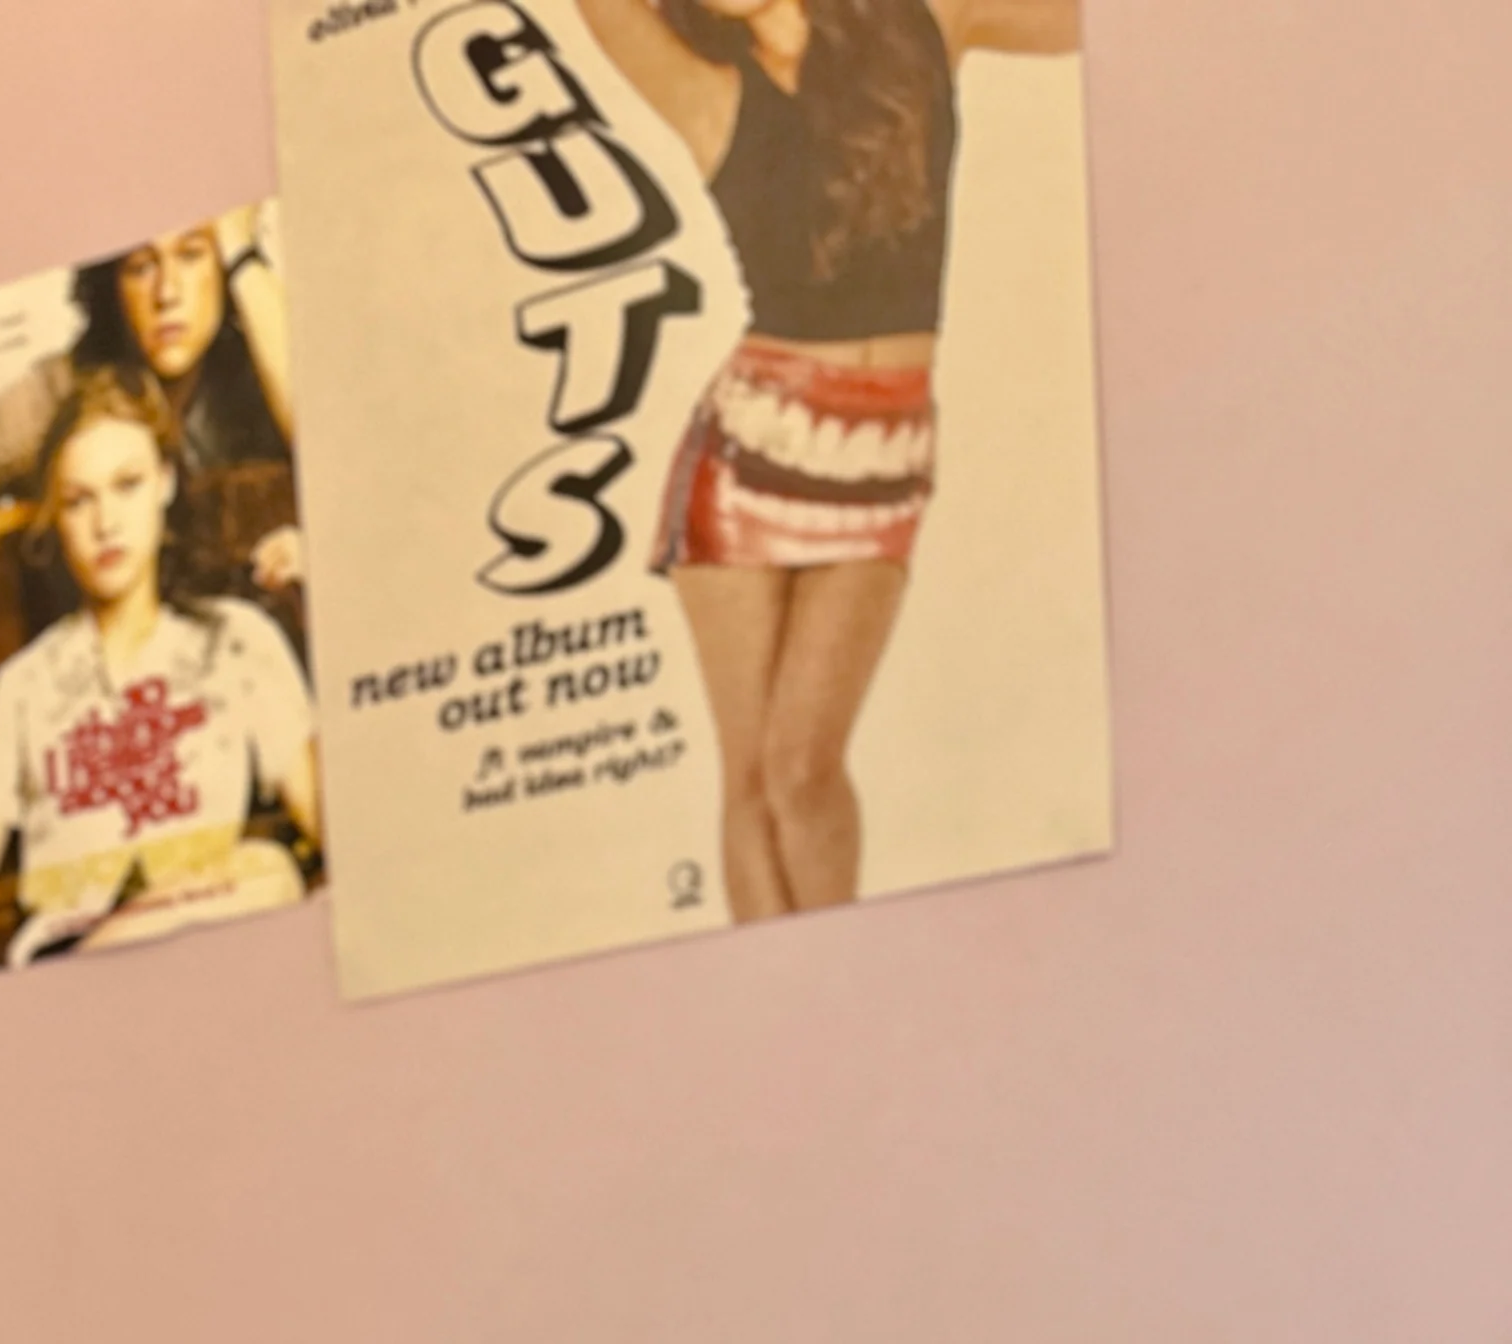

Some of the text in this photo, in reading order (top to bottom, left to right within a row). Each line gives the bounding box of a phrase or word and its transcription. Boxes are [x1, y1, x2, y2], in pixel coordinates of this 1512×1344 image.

[413, 0, 702, 598] GUTS
[350, 606, 650, 710] new album
[437, 648, 661, 734] out now
